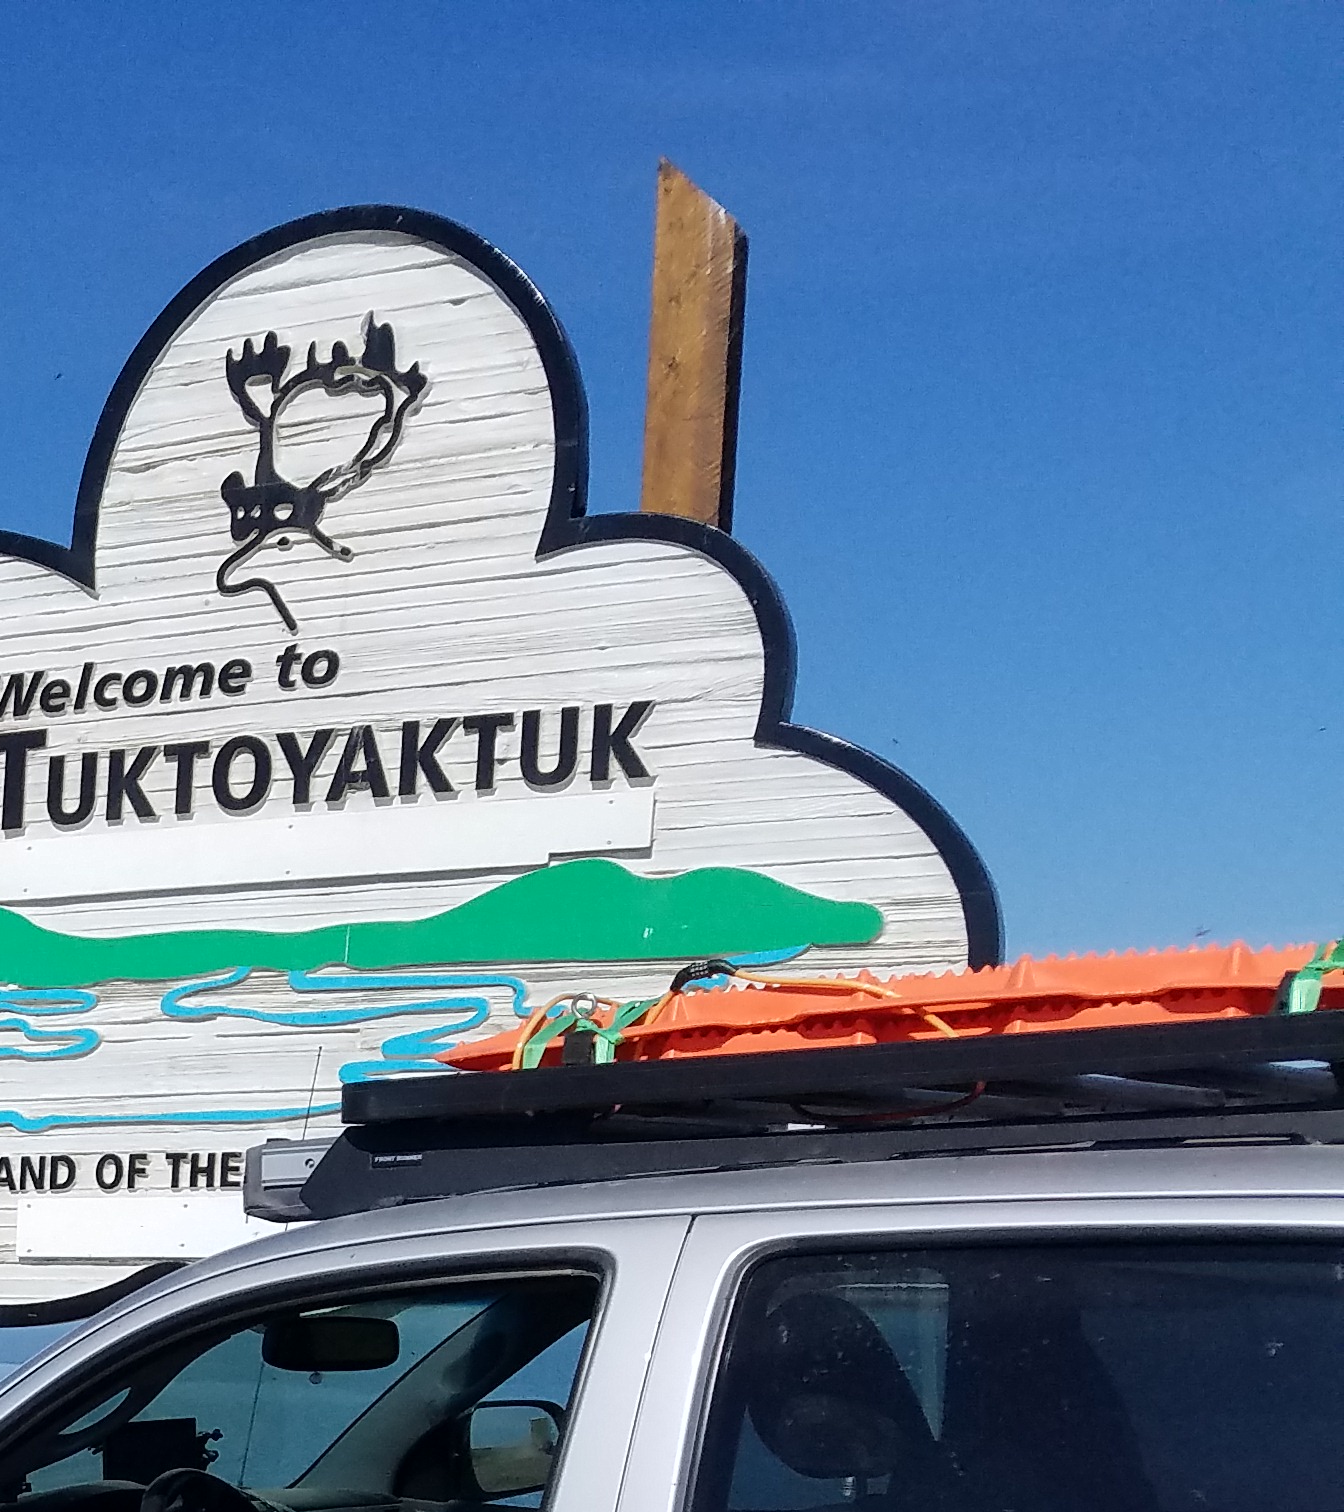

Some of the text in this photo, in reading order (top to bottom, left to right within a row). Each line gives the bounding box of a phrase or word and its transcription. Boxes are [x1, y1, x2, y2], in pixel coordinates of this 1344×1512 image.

[275, 643, 341, 690] to
[95, 1153, 149, 1192] OF
[165, 1151, 243, 1190] THE
